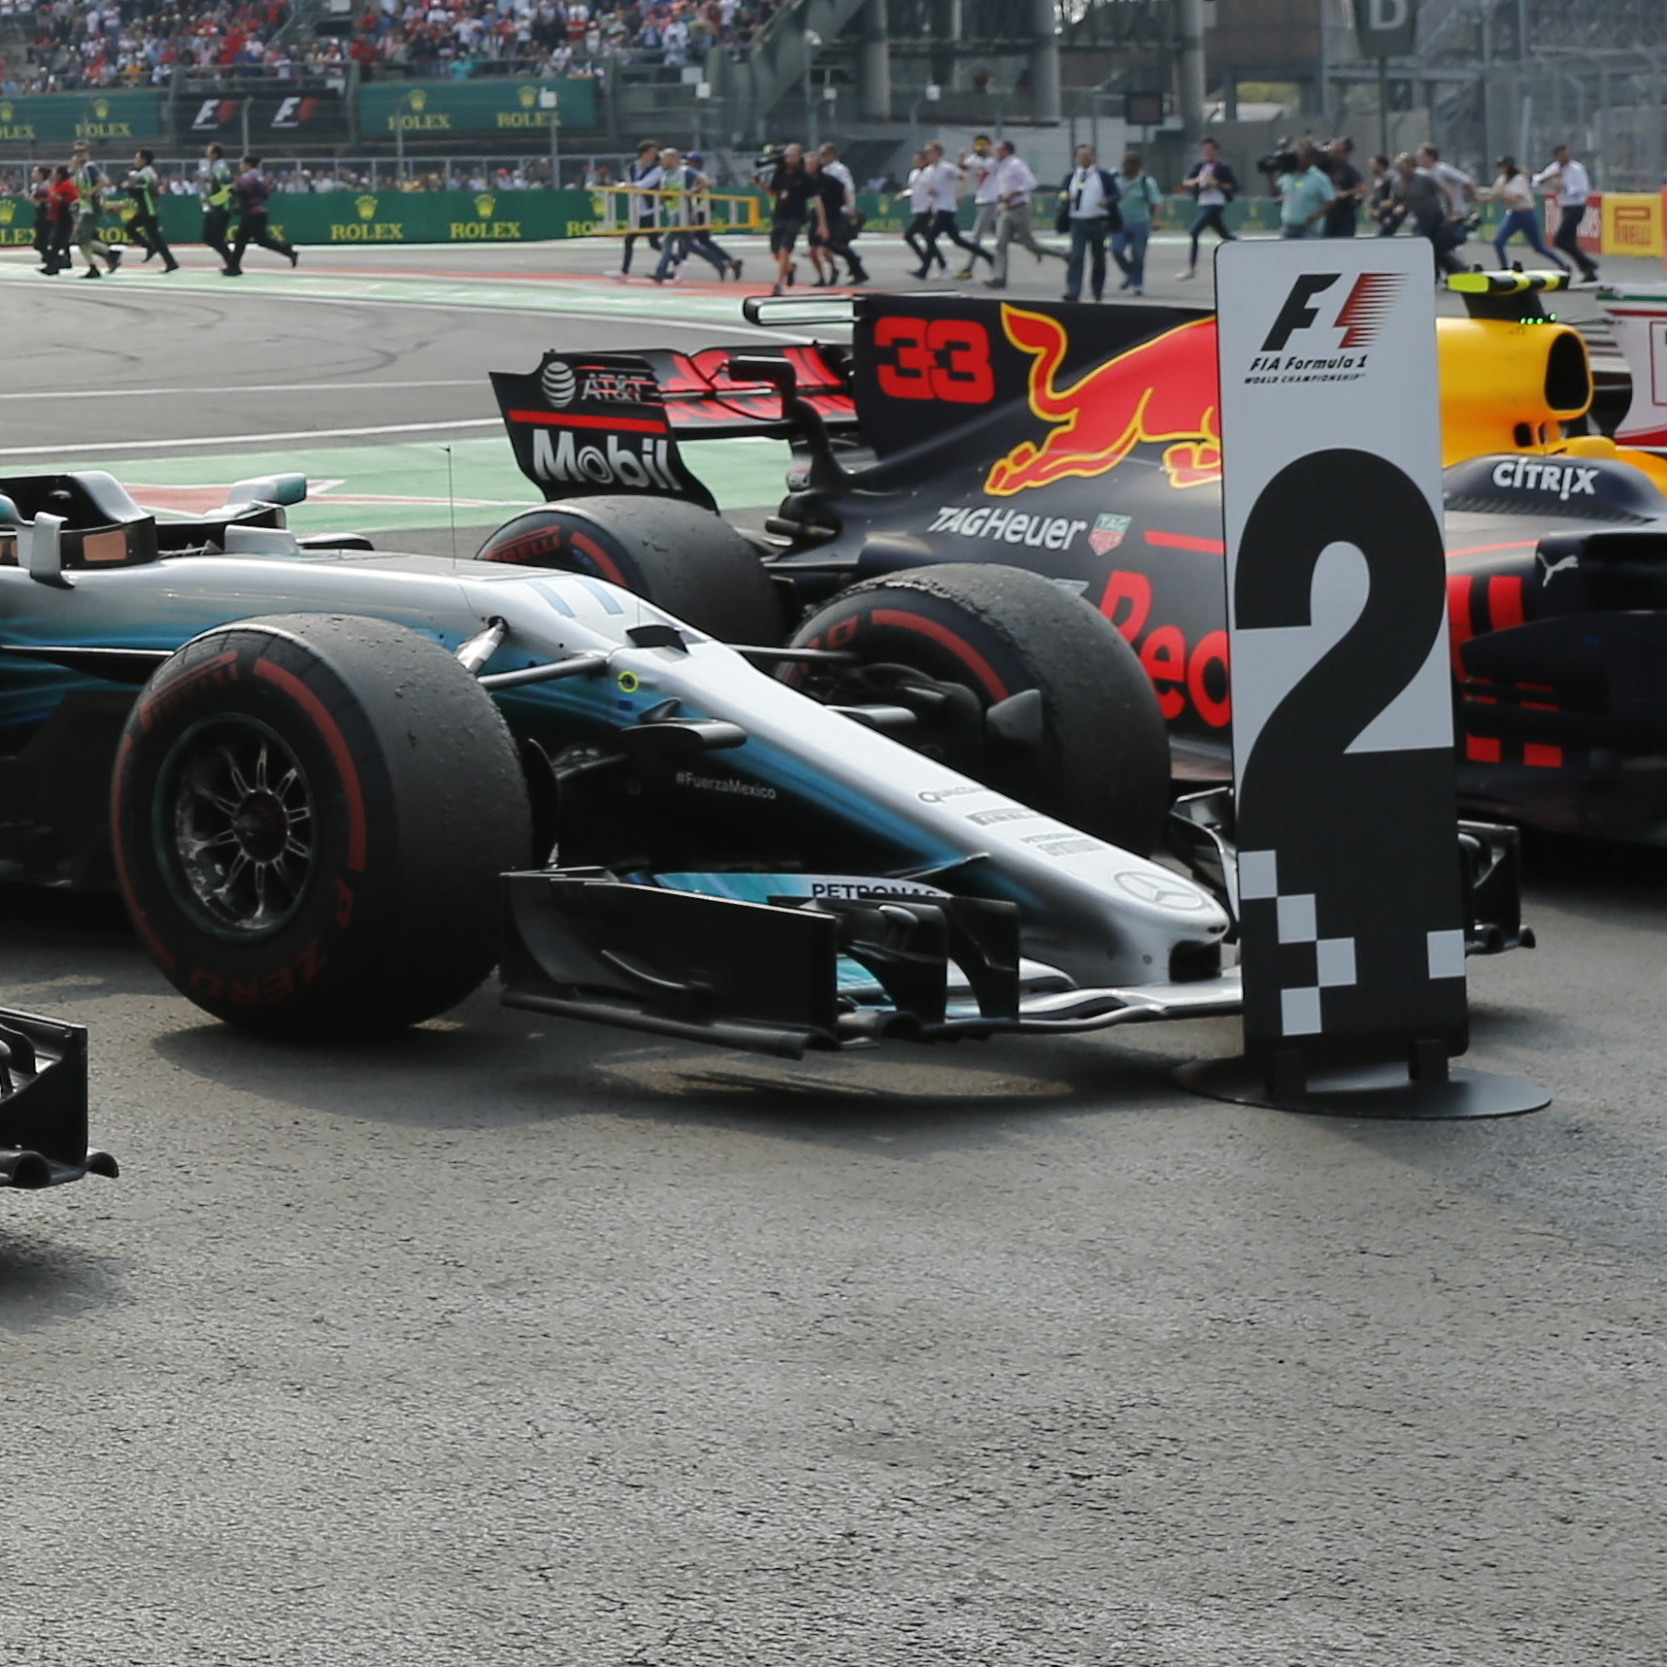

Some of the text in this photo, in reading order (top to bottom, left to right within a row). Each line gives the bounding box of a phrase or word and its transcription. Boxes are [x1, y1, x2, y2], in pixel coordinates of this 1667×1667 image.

[330, 221, 522, 241] ROLEX ROLEX
[1260, 272, 1411, 352] F1
[874, 316, 995, 404] 33
[1250, 354, 1369, 372] FIA Formula 1
[533, 428, 683, 491] Mobil
[1234, 447, 1457, 799] 2
